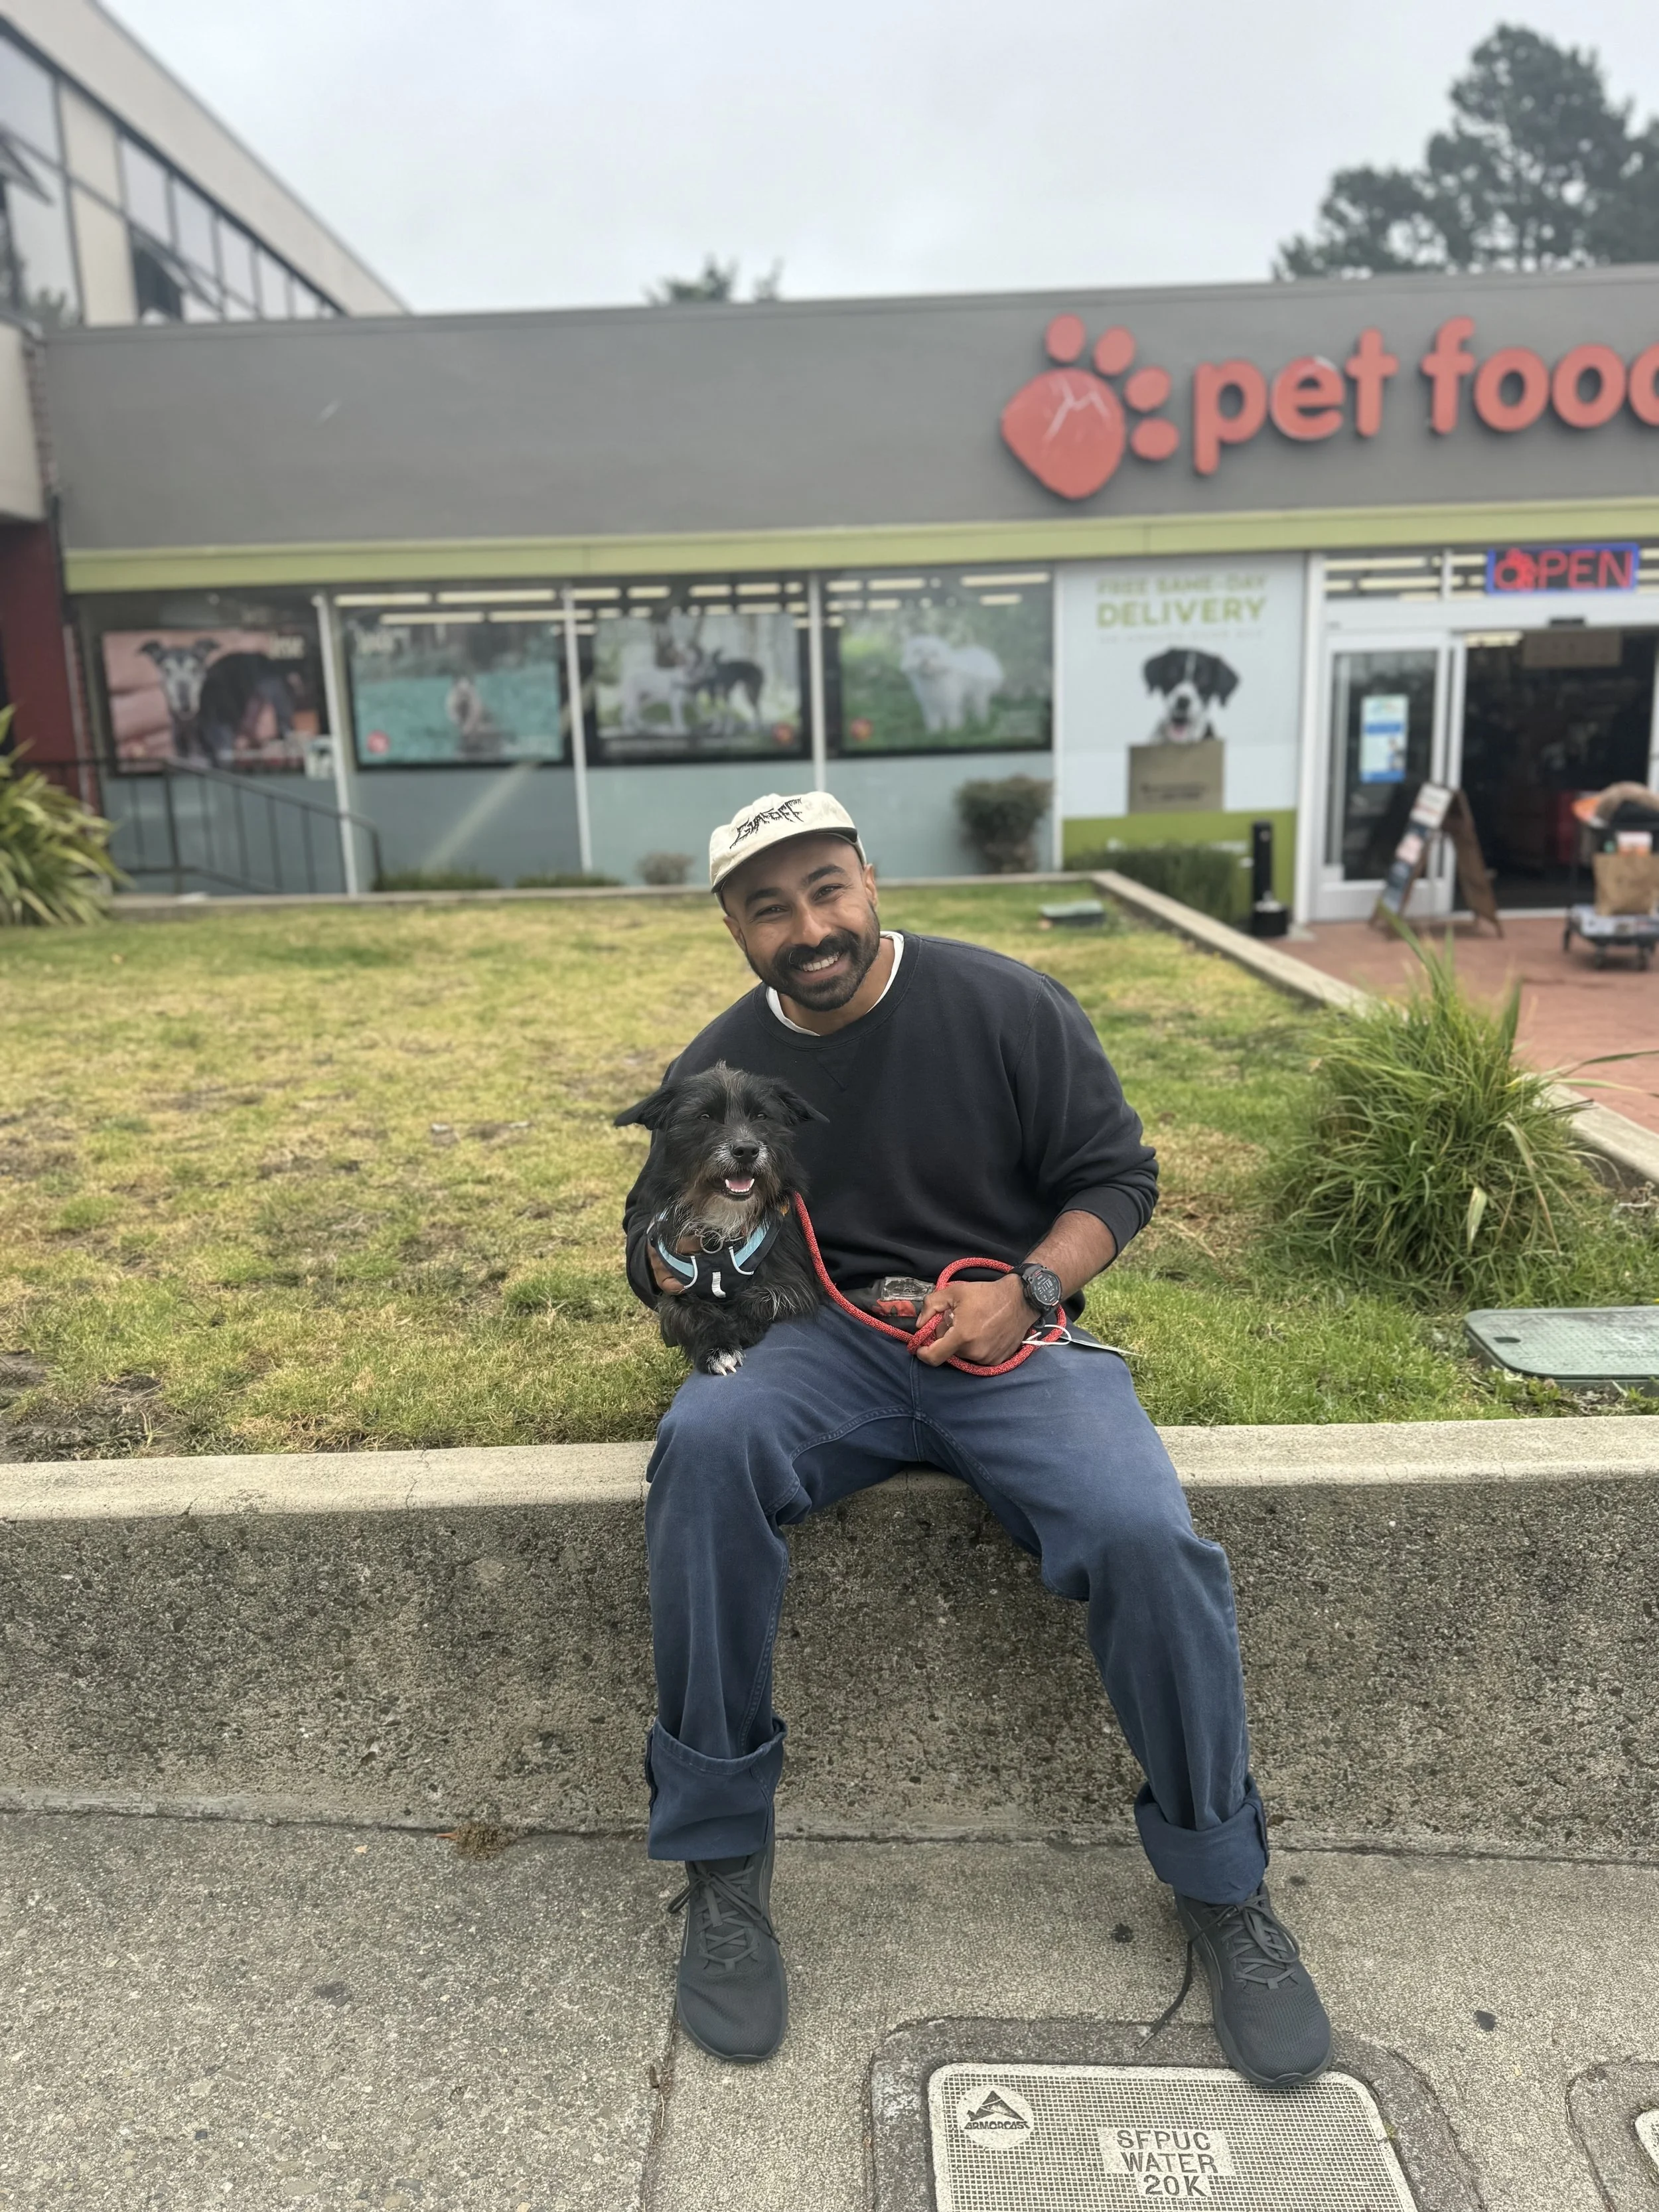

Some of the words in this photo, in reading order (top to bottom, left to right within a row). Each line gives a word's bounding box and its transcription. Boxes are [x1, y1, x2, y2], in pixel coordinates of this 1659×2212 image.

[1194, 328, 1398, 474] pet
[1494, 548, 1633, 590] OPEN
[1098, 597, 1266, 628] DELIVERY
[964, 2120, 1030, 2130] ARMORCAST
[1117, 2129, 1211, 2150] SFPUC
[1121, 2152, 1218, 2174] WATER
[1143, 2174, 1207, 2197] 20K
